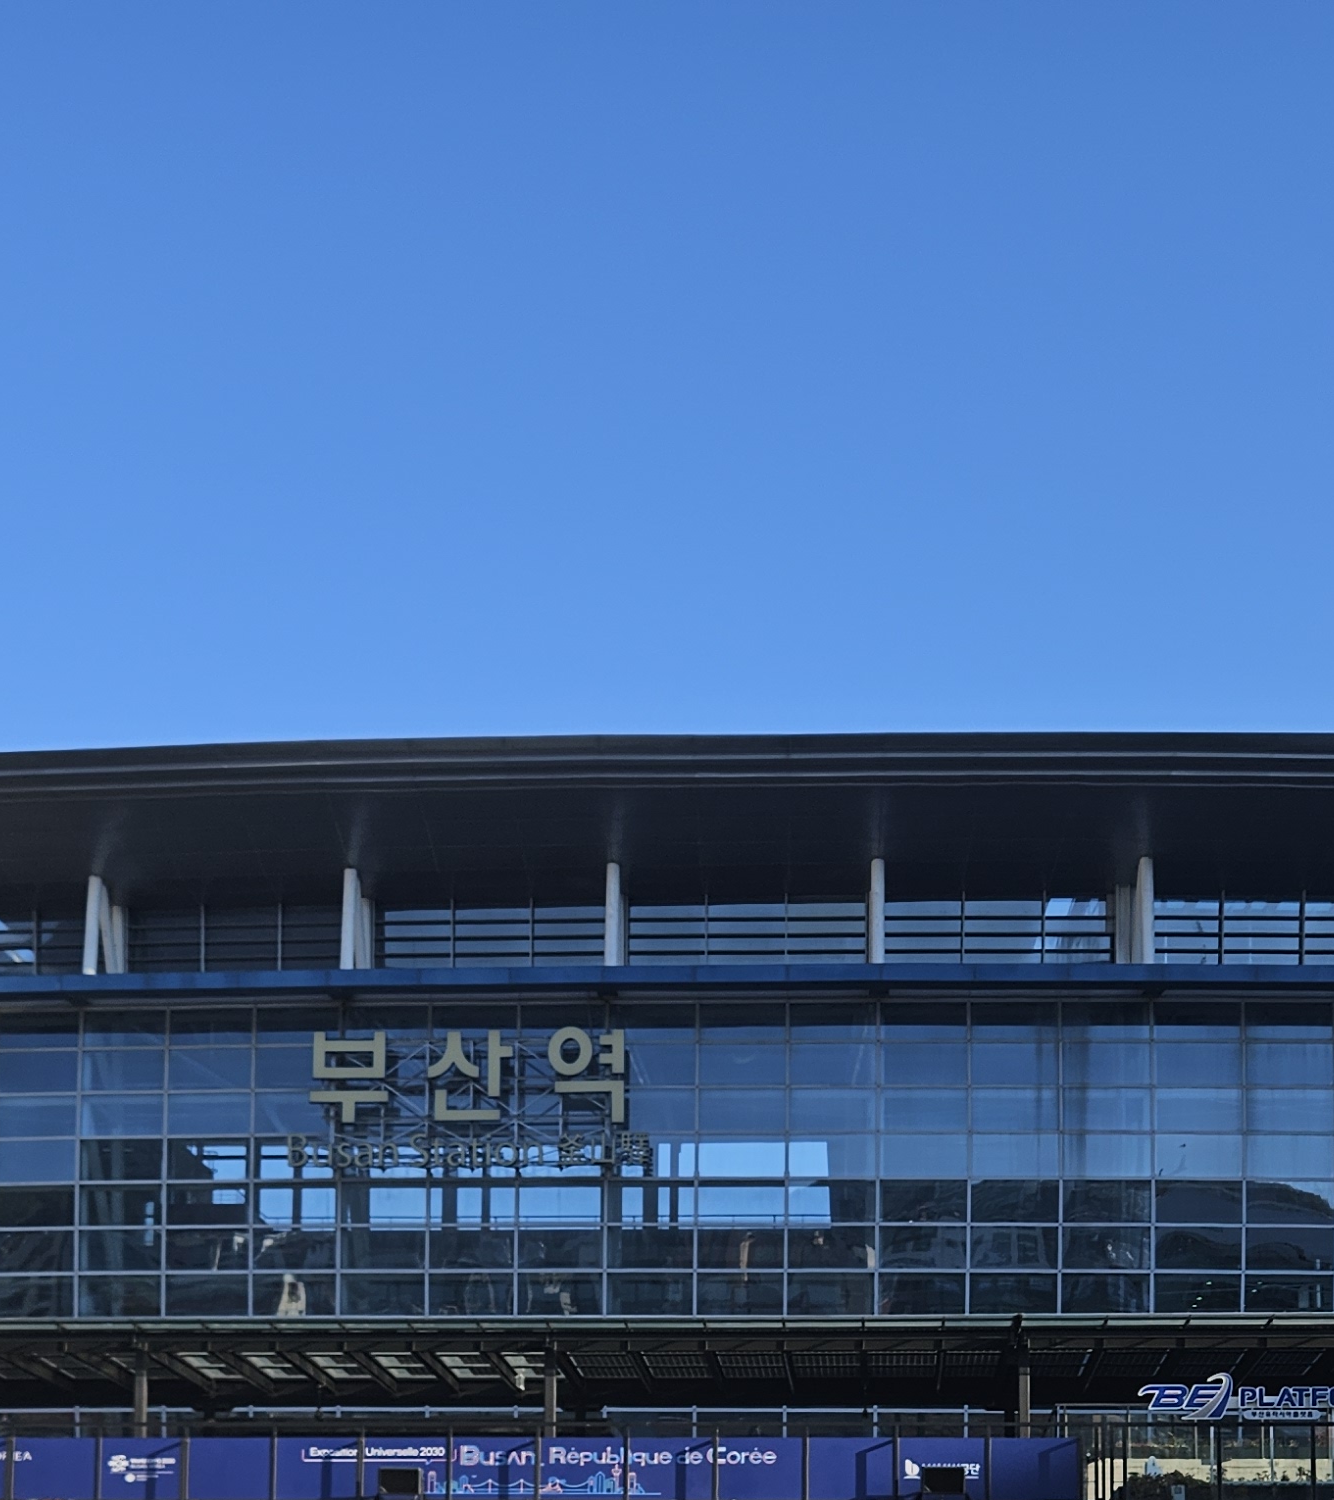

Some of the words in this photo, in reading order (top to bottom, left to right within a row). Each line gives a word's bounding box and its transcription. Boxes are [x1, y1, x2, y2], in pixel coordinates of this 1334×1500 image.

[310, 1026, 625, 1123] 부산역
[287, 1134, 398, 1168] Busan
[410, 1134, 544, 1168] Station
[420, 1447, 446, 1457] 2030
[676, 1446, 703, 1465] de
[706, 1446, 778, 1465] Corée
